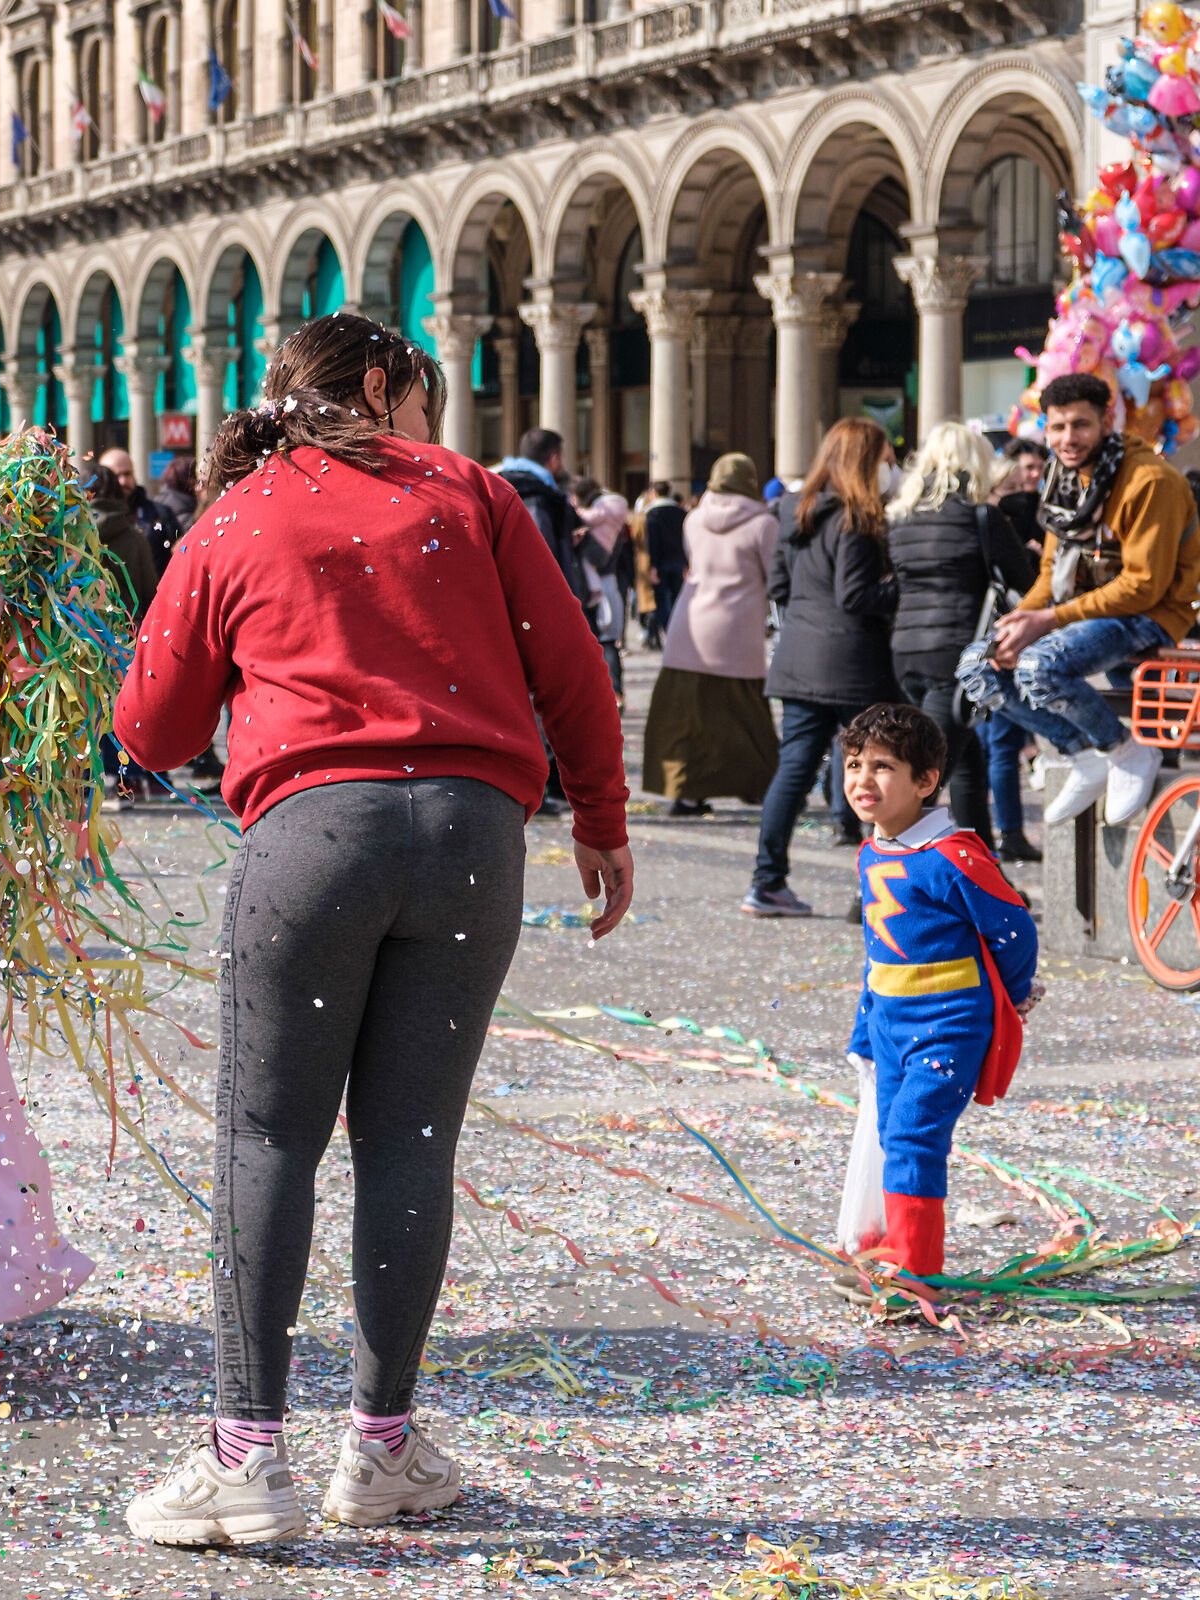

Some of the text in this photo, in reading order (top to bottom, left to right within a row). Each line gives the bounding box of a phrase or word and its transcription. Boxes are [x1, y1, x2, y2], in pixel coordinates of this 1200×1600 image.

[166, 420, 190, 441] M
[221, 1016, 232, 1074] HAPPEN
[217, 1079, 231, 1119] MAKE
[222, 1335, 243, 1375] MAKE
